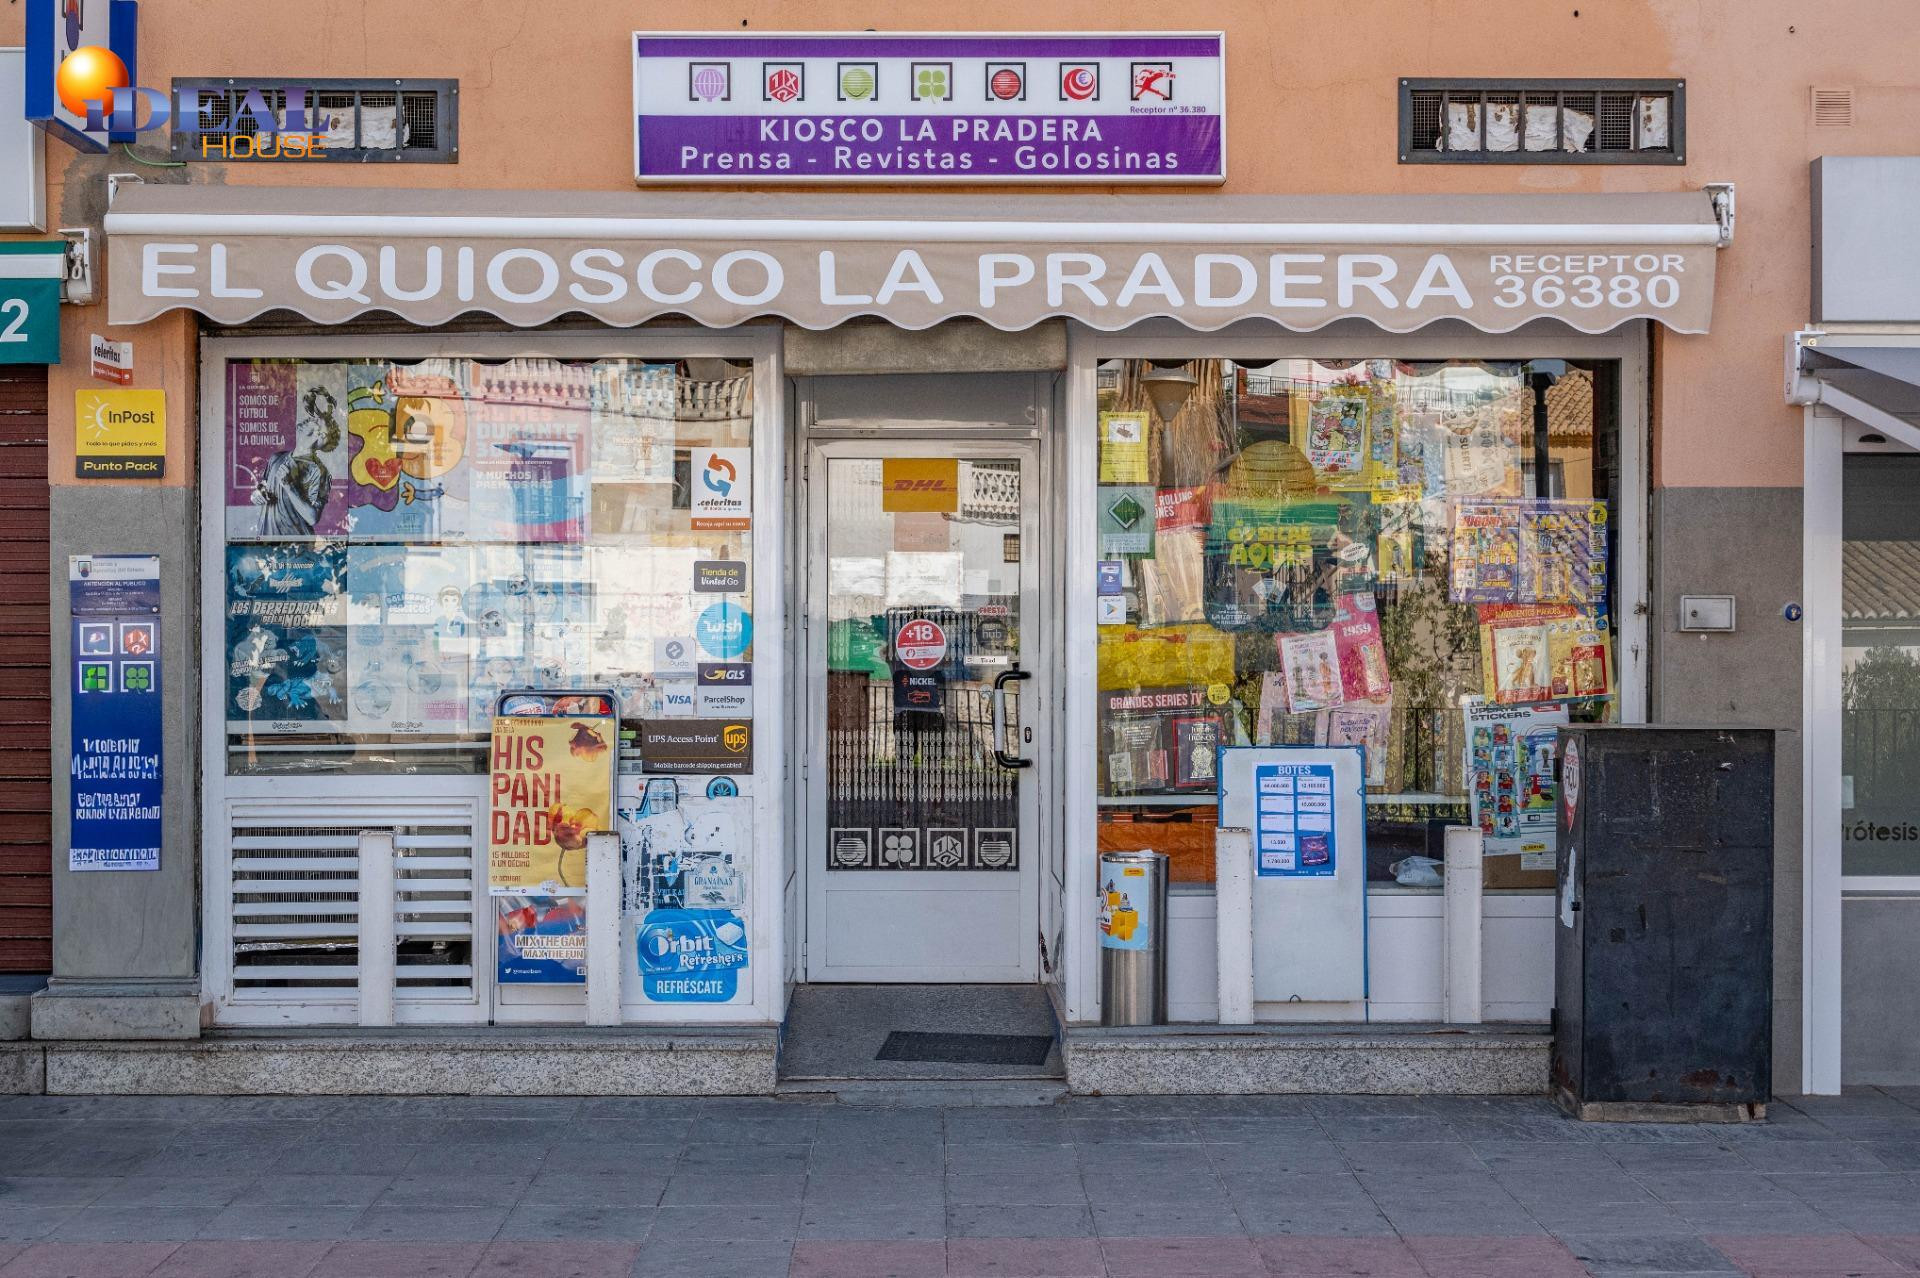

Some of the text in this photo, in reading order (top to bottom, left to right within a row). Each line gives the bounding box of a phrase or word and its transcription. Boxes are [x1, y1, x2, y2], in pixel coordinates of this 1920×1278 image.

[1130, 106, 1167, 115] Receptor
[759, 119, 1103, 142] KIOSCO LA PRADERA
[681, 146, 792, 169] Prensa
[834, 146, 973, 169] Revistas
[1015, 146, 1179, 169] Golosinas
[1490, 254, 1685, 273] RECEPTOR
[142, 243, 1474, 309] EL QUIOSCO LA PRADERA
[1493, 275, 1681, 308] 36380
[0, 298, 30, 343] 2
[239, 394, 279, 406] SOMOS DE
[108, 410, 155, 424] InPost
[239, 406, 269, 419] FÚTBOL
[239, 422, 279, 433] SOMOS DE
[239, 435, 286, 446] LA QUINIELA
[83, 461, 158, 471] Punto Pack
[488, 471, 532, 480] MUCHOS
[891, 479, 948, 492] DHL
[1158, 491, 1193, 507] ROLLING
[701, 568, 738, 576] Tienda de
[701, 577, 739, 586] Vinted Go
[979, 606, 1007, 615] FIESTA
[704, 618, 743, 633] wish
[905, 624, 934, 641] +18
[982, 628, 1002, 639] hub
[726, 670, 745, 680] GLS
[665, 694, 692, 705] VISA
[704, 695, 746, 705] ParcelShop
[1110, 692, 1204, 710] GRANDES SERIES TV
[1470, 711, 1531, 722] STICKERS
[648, 734, 715, 743] UPS Access Point
[726, 735, 747, 748] ups
[493, 734, 544, 771] HIS
[696, 762, 720, 770] shipping
[1278, 765, 1312, 775] BOTES
[492, 772, 561, 808] PANI
[491, 810, 552, 846] DAD
[1841, 819, 1919, 841] rótesis
[516, 935, 587, 947] MIX THE GAM
[648, 928, 714, 957] Orbit
[523, 949, 583, 959] MAX THE FUN
[679, 953, 744, 970] Refreshers
[656, 978, 724, 994] REFRÉSCATE
